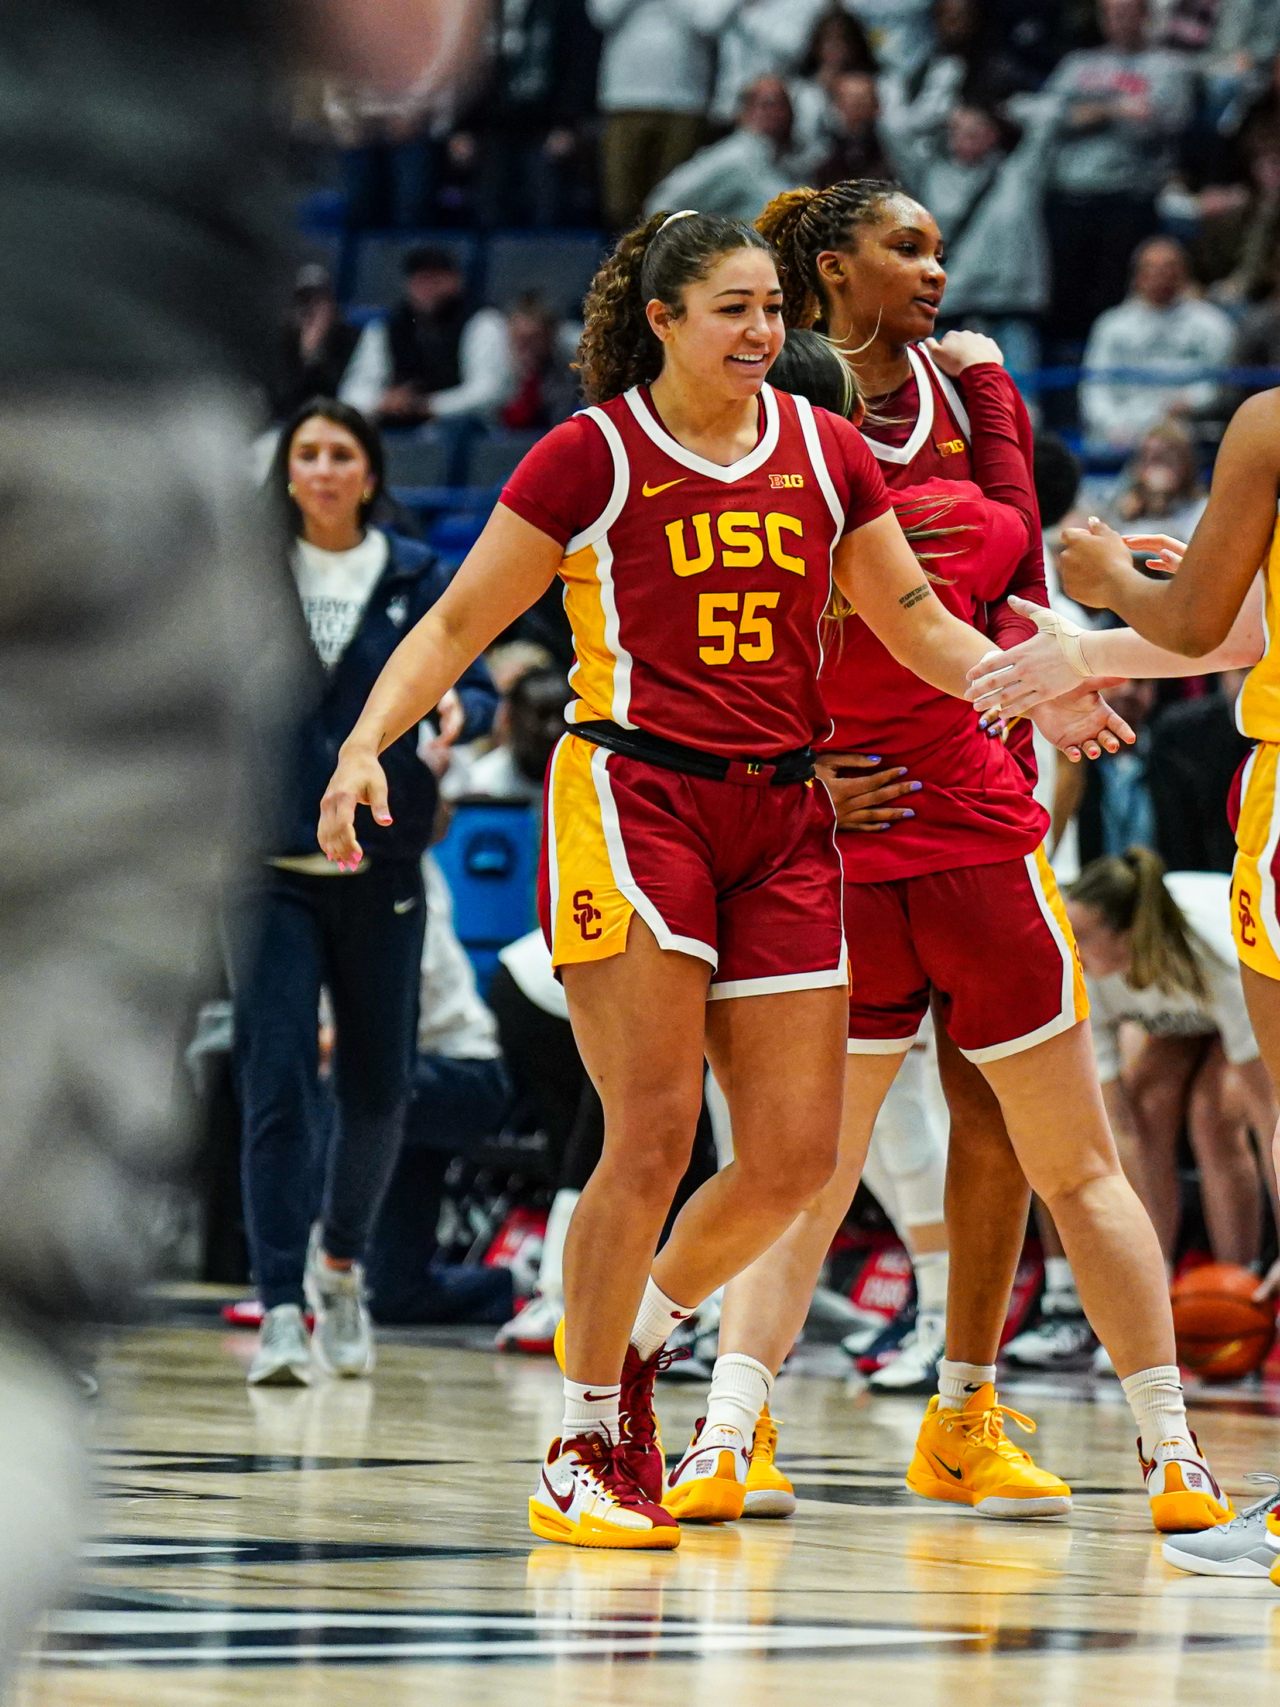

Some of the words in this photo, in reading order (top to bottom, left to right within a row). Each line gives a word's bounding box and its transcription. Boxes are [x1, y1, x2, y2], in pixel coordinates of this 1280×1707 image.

[664, 510, 807, 578] USC
[698, 591, 781, 666] 55
[573, 889, 603, 941] SC
